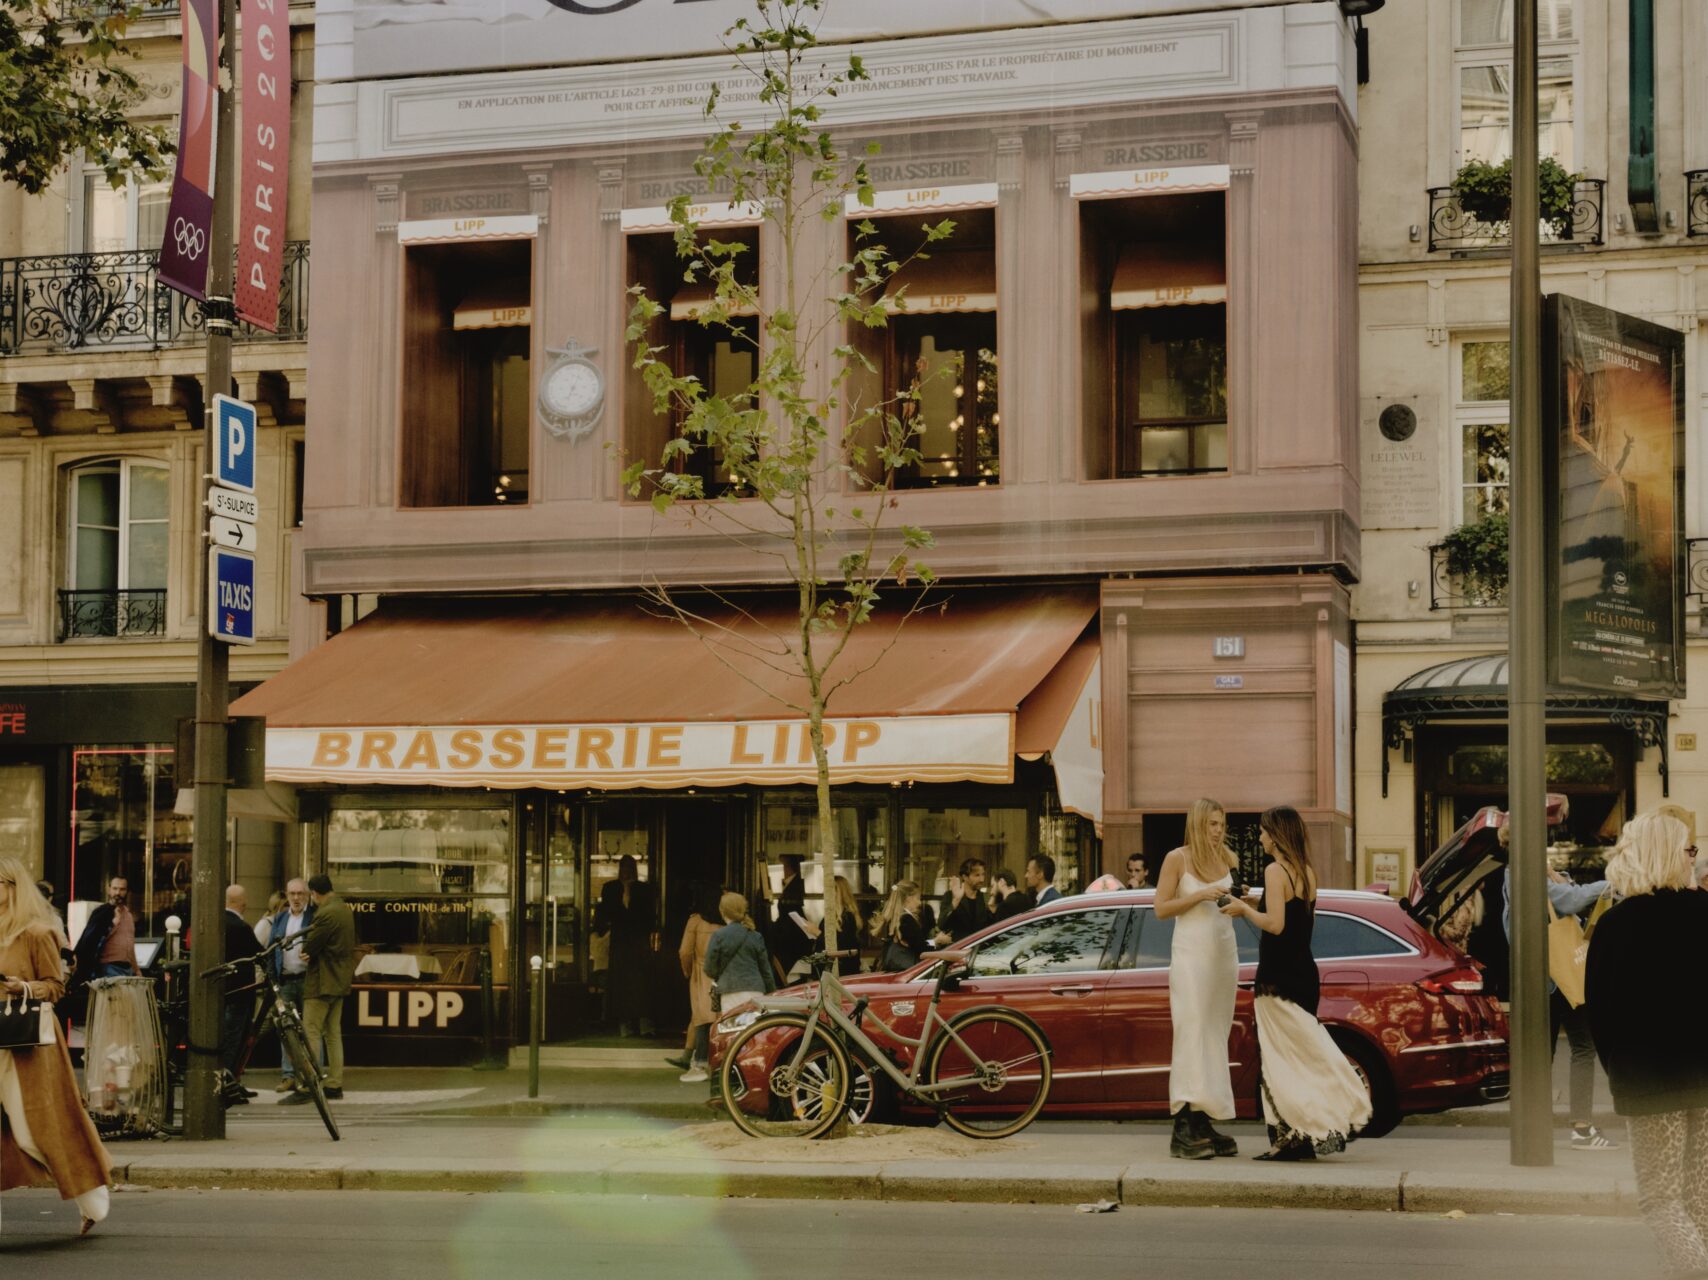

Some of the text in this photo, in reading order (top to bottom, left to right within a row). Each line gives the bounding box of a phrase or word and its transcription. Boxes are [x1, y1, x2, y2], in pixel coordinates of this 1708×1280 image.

[458, 99, 472, 109] EN
[475, 94, 545, 108] APPLICATION
[548, 93, 563, 103] DE
[565, 89, 619, 102] L'ARTICLE
[677, 82, 692, 93] DU
[727, 79, 743, 88] DU
[903, 60, 953, 74] PERÇUES
[956, 59, 980, 69] PAR
[982, 57, 996, 67] LE
[999, 49, 1084, 66] PROPRIÉTAIRE
[1087, 48, 1104, 59] DU
[1107, 41, 1179, 57] MONUMENT
[604, 101, 633, 112] POUR
[635, 99, 656, 109] CET
[721, 91, 763, 104] SERON
[851, 76, 935, 93] FINANCEMENT
[937, 74, 959, 85] DES
[1104, 141, 1209, 166] BRASSERIE
[870, 160, 971, 182] BRASSERIE
[1134, 170, 1170, 185] LIPP
[422, 191, 515, 214] BRASSERIE
[907, 189, 940, 203] LIPP
[454, 219, 486, 233] LIPP
[929, 295, 967, 308] LIPP
[1154, 286, 1193, 301] LIPP
[492, 307, 527, 322] LIPP
[228, 415, 246, 469] P
[1370, 451, 1426, 462] LELEWEL
[219, 580, 251, 611] TAXIS
[1584, 610, 1656, 633] MEGALOPOLIS
[1216, 637, 1241, 657] 151
[310, 721, 882, 771] BRASSERIE LIPP
[346, 902, 376, 913] VICE
[385, 902, 437, 913] CONTINU
[358, 990, 464, 1028] LIPP
